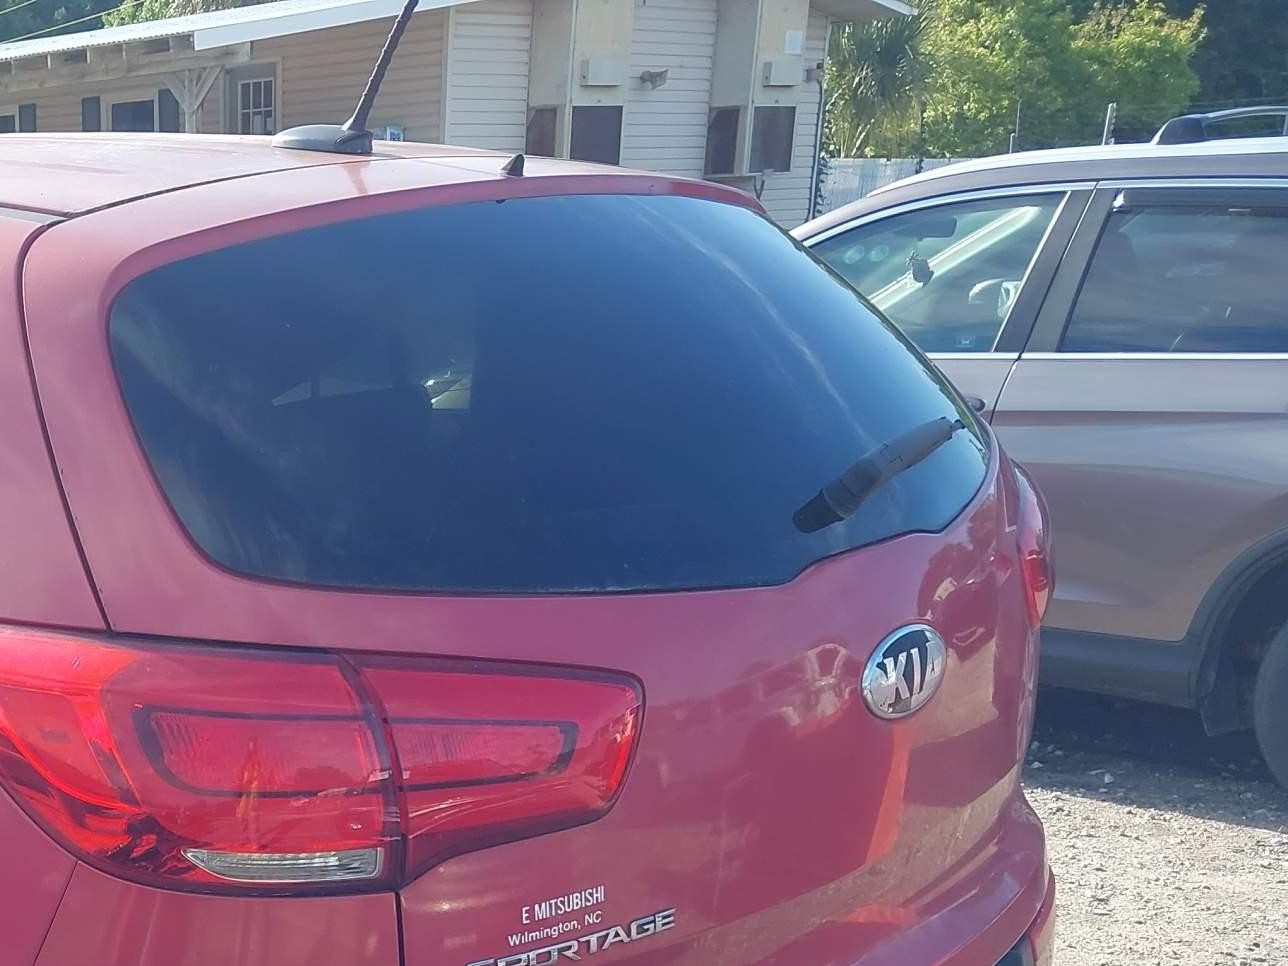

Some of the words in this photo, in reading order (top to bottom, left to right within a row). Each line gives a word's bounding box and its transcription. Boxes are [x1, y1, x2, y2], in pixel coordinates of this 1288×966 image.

[876, 642, 943, 710] KIA
[521, 905, 532, 924] E
[534, 885, 606, 921] MITSUBISHI
[507, 921, 582, 948] Wilmington,
[584, 910, 603, 925] NC
